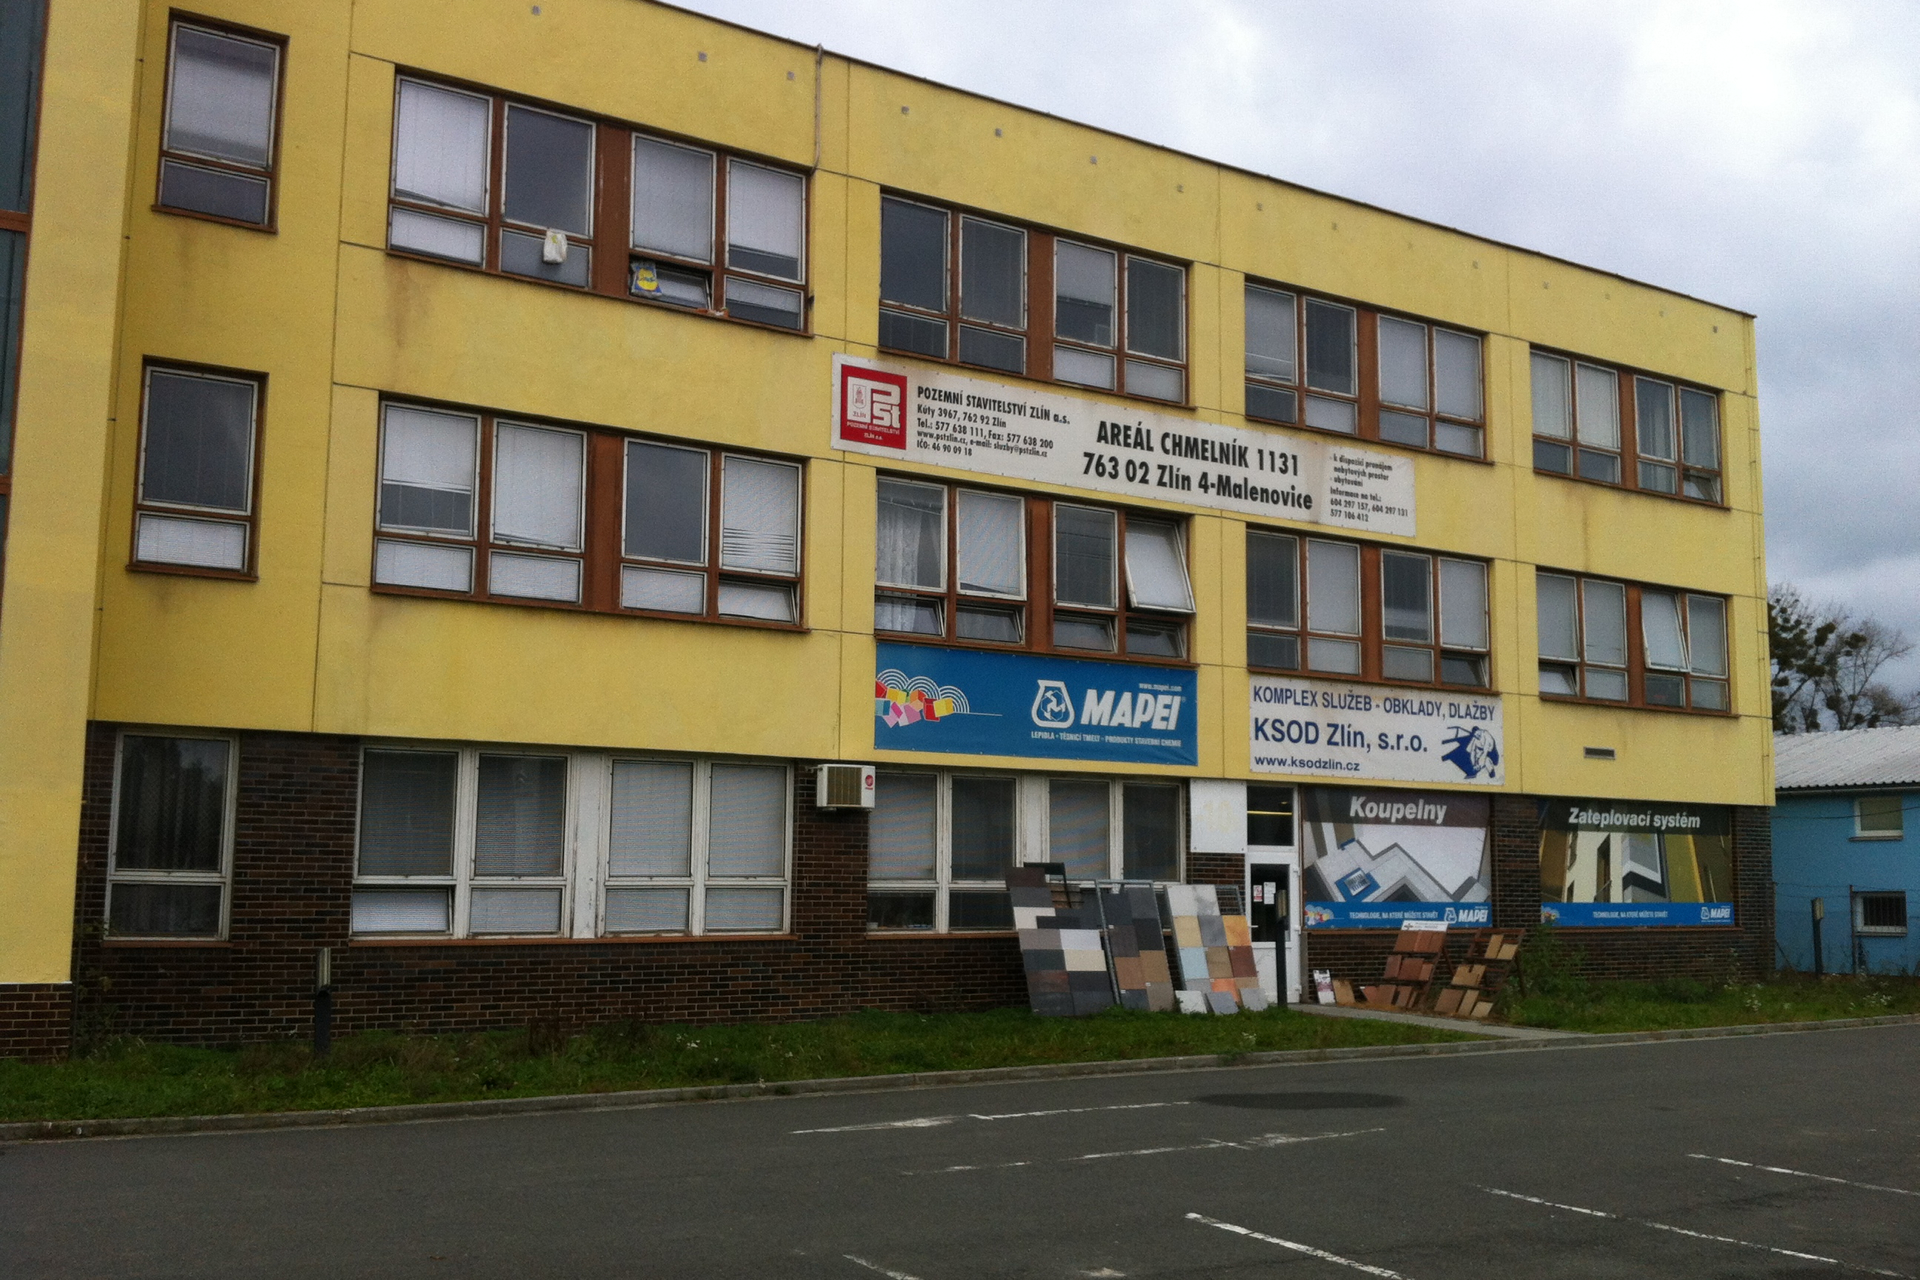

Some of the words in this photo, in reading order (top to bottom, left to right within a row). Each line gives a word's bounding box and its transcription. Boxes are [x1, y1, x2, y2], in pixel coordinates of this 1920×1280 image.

[917, 386, 963, 406] POZEMNÍ
[966, 394, 1027, 417] STAVITELSTVÍ
[1029, 405, 1051, 421] ZLÍN
[1053, 413, 1070, 425] a.s.
[917, 404, 936, 418] Kúty
[938, 407, 961, 422] 3967,
[962, 411, 978, 423] 762
[980, 415, 990, 425] 92
[992, 417, 1006, 428] Zlín
[917, 418, 933, 430] Tel.:
[935, 420, 950, 432] 577
[952, 423, 967, 435] 638
[988, 429, 1004, 441] Fax:
[1006, 432, 1021, 444] 577
[1023, 435, 1037, 447] 638
[1039, 438, 1054, 449] 200
[932, 442, 941, 452] 46
[943, 443, 952, 453] 90
[953, 445, 962, 455] 09
[964, 446, 973, 457] 18
[1096, 420, 1154, 452] AREÁL
[1161, 432, 1250, 468] CHMELNÍK
[1257, 448, 1298, 477] 1131
[1083, 451, 1119, 480] 763
[1125, 458, 1149, 485] 02
[1157, 464, 1192, 491] Zlín
[1198, 471, 1313, 510] 4-Malenovice
[1330, 498, 1342, 507] 604
[1344, 500, 1355, 509] 297
[1385, 506, 1396, 515] 297
[1397, 508, 1408, 517] 131
[1330, 509, 1342, 517] 577
[1344, 511, 1355, 520] 106
[1357, 513, 1369, 522] 412
[1080, 688, 1182, 731] MAPEI
[1253, 685, 1318, 708] KOMPLEX
[1322, 689, 1372, 712] SLUŽEB
[1383, 697, 1446, 720] OBKLADY,
[1449, 700, 1495, 721] DLAŽBY
[1031, 731, 1055, 740] LEPIDLA
[1254, 717, 1320, 745] KSOD
[1326, 722, 1371, 753] Zlín,
[1378, 732, 1428, 752] s.r.o.
[1254, 756, 1360, 771] www.ksodzlin.cz
[1349, 795, 1447, 824] Koupelny
[1568, 807, 1650, 828] Zateplovací
[1653, 811, 1700, 830] systém
[1458, 909, 1488, 923] MAPEI
[1710, 908, 1731, 919] MAPEI
